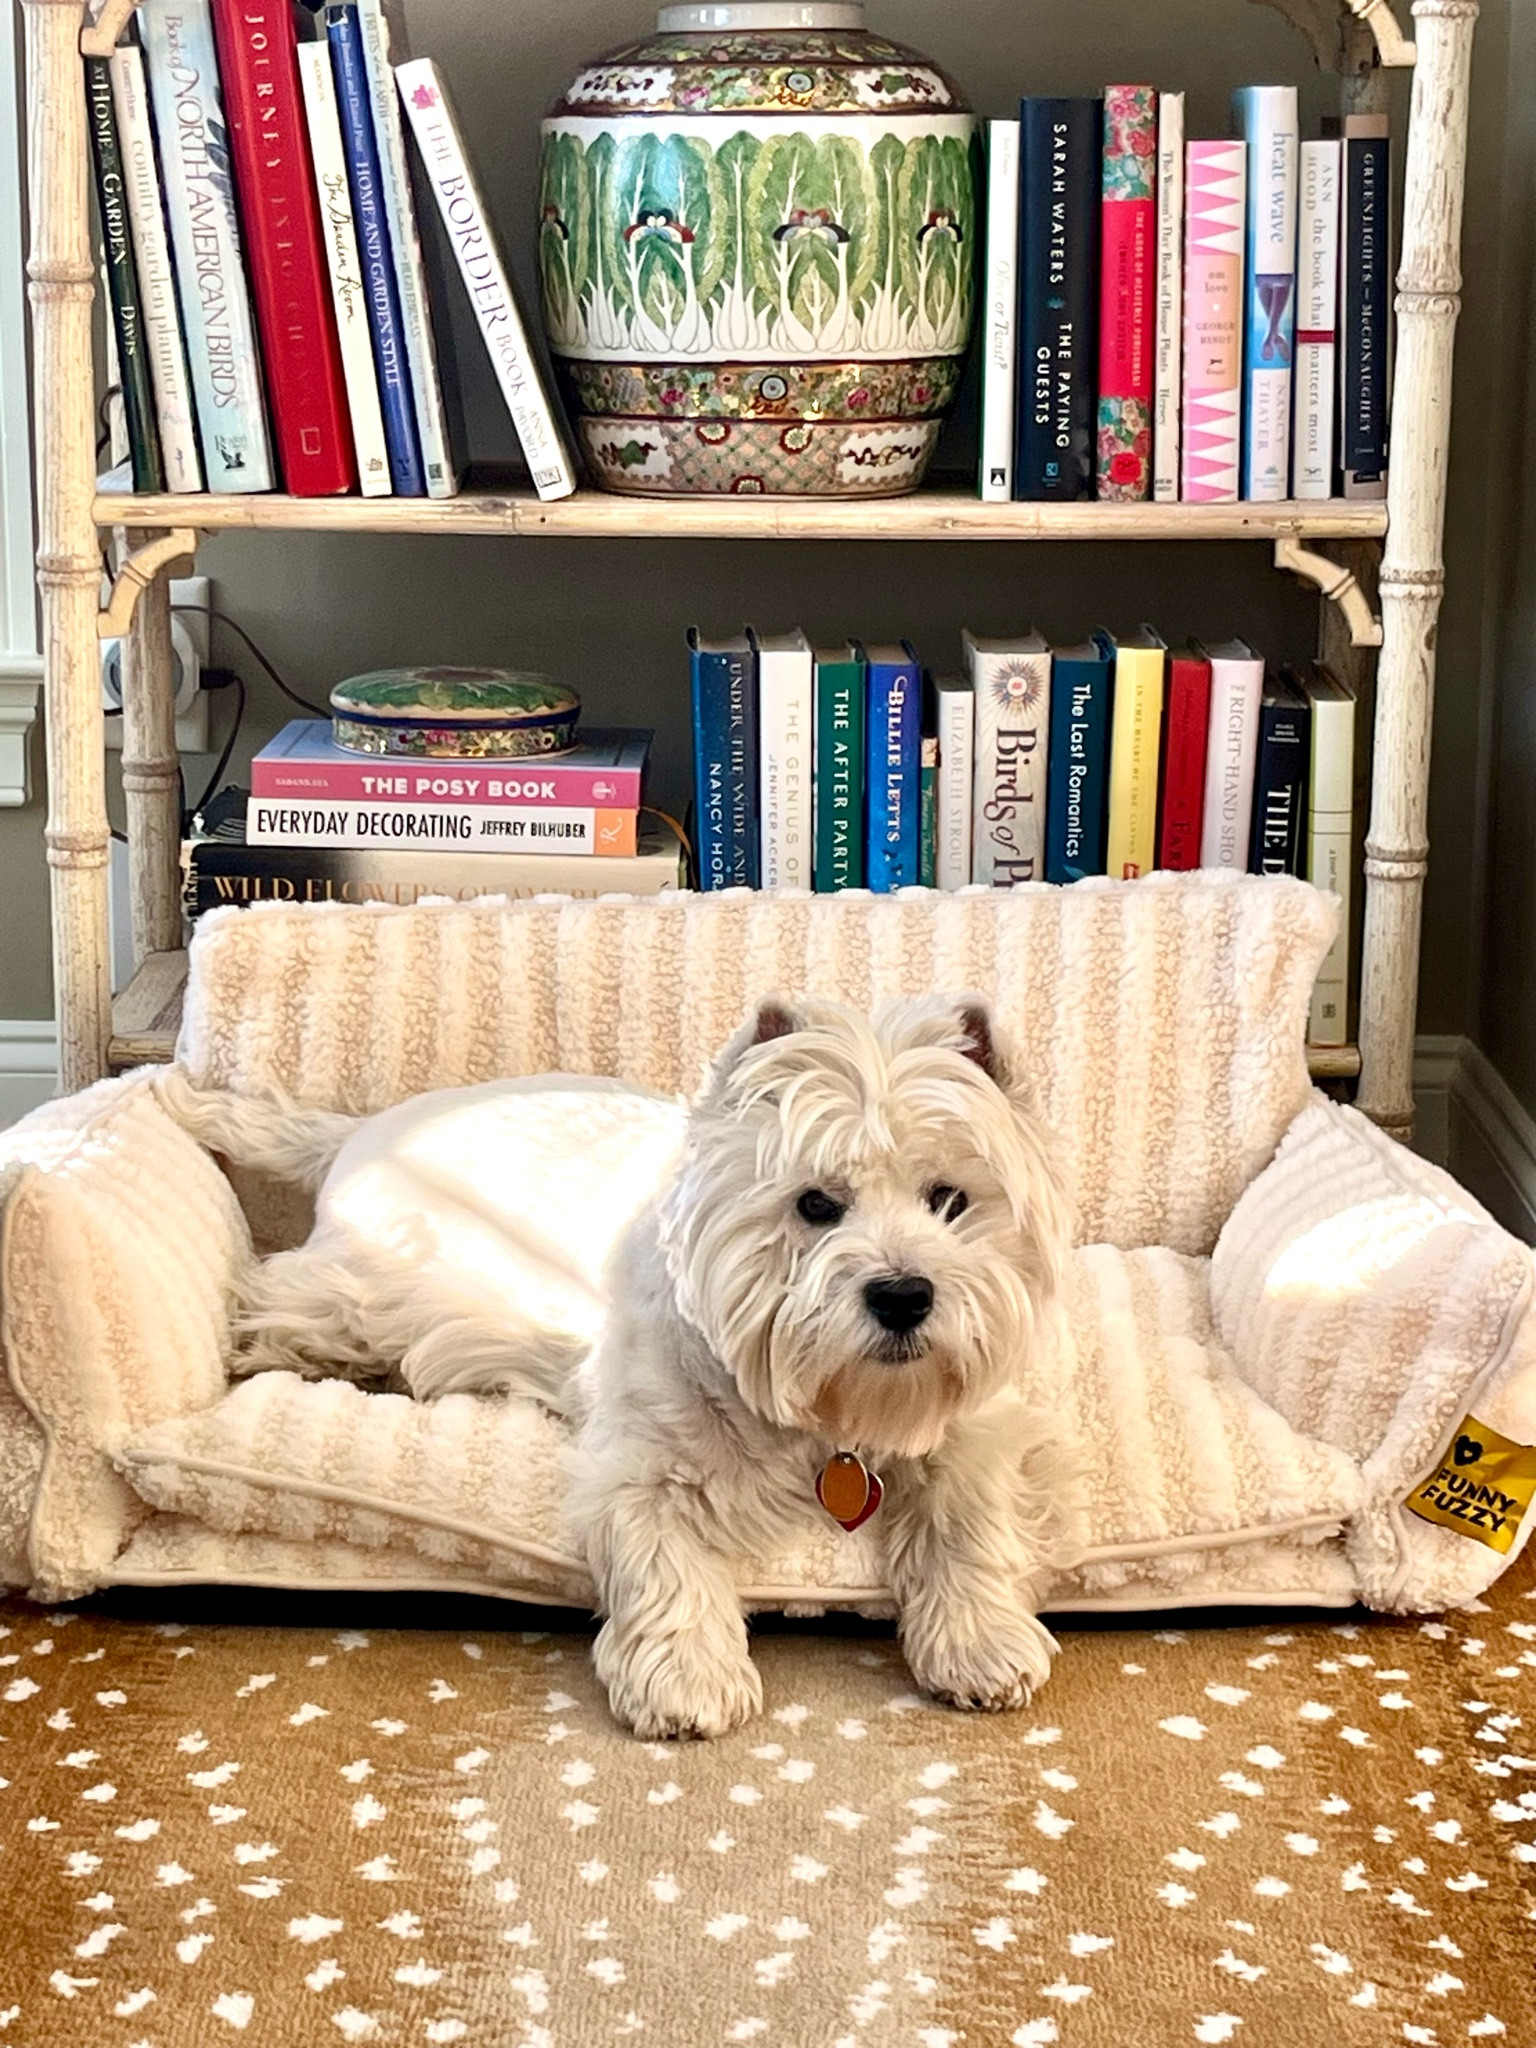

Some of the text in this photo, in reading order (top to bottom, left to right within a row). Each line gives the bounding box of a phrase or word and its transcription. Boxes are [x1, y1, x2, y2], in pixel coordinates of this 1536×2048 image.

[165, 53, 191, 71] of
[171, 67, 208, 179] NORTH
[1160, 150, 1173, 172] The
[91, 82, 113, 149] HOME
[102, 172, 128, 265] GARDEN
[1049, 123, 1067, 283] SARAH WATERS
[1268, 131, 1292, 244] heat wave
[1304, 156, 1317, 210] HOOD
[1320, 164, 1332, 202] ANN
[322, 171, 347, 202] The
[336, 272, 365, 324] Room
[1360, 153, 1375, 283] GREENLIGHTS
[131, 140, 177, 402] country garden planner
[185, 184, 231, 330] AMERICAN
[355, 161, 400, 388] HOME AND GARDEN STYLE
[425, 122, 528, 397] THE BORDER BOOK
[1160, 285, 1171, 295] of
[1161, 252, 1172, 279] Book
[119, 305, 140, 355] DAVIS
[992, 319, 1009, 369] Twist?
[993, 301, 1004, 316] or
[1159, 300, 1171, 334] House
[1307, 218, 1325, 452] the book that matters most
[204, 332, 240, 409] BIRDS
[1034, 346, 1050, 424] GUESTS
[1055, 322, 1072, 449] THE PAYING
[1358, 303, 1372, 433] McCONAUGHEY
[513, 405, 539, 460] PAVORD
[528, 408, 549, 448] ANNA
[1256, 380, 1272, 450] THAYER
[1273, 383, 1286, 444] NANCY
[1134, 702, 1142, 723] THE
[1135, 685, 1143, 696] IN
[361, 777, 556, 799] THE POSY BOOK
[727, 662, 747, 885] UNDER THE WIDE AND
[785, 700, 799, 887] THE GENIUS OF
[832, 689, 849, 887] THE AFTER PARTY
[886, 683, 906, 842] BILLIE LETTS
[948, 705, 965, 873] ELIZABETH STROUT
[982, 723, 1039, 824] Birds
[1063, 683, 1092, 858] The Last Romantics
[1223, 696, 1245, 821] RIGHT-HAND
[257, 809, 586, 840] EVERYDAY DECORATING JEFFREY BILHUBER
[708, 763, 724, 890] NANCY HOR
[768, 754, 777, 891] JENNIFER ACKER
[986, 824, 1022, 855] of
[1218, 824, 1236, 867] SHO
[1265, 784, 1292, 848] THE
[213, 876, 295, 901] WILD
[1419, 1484, 1506, 1533] FUZZY
[1435, 1467, 1518, 1513] FUNNY
